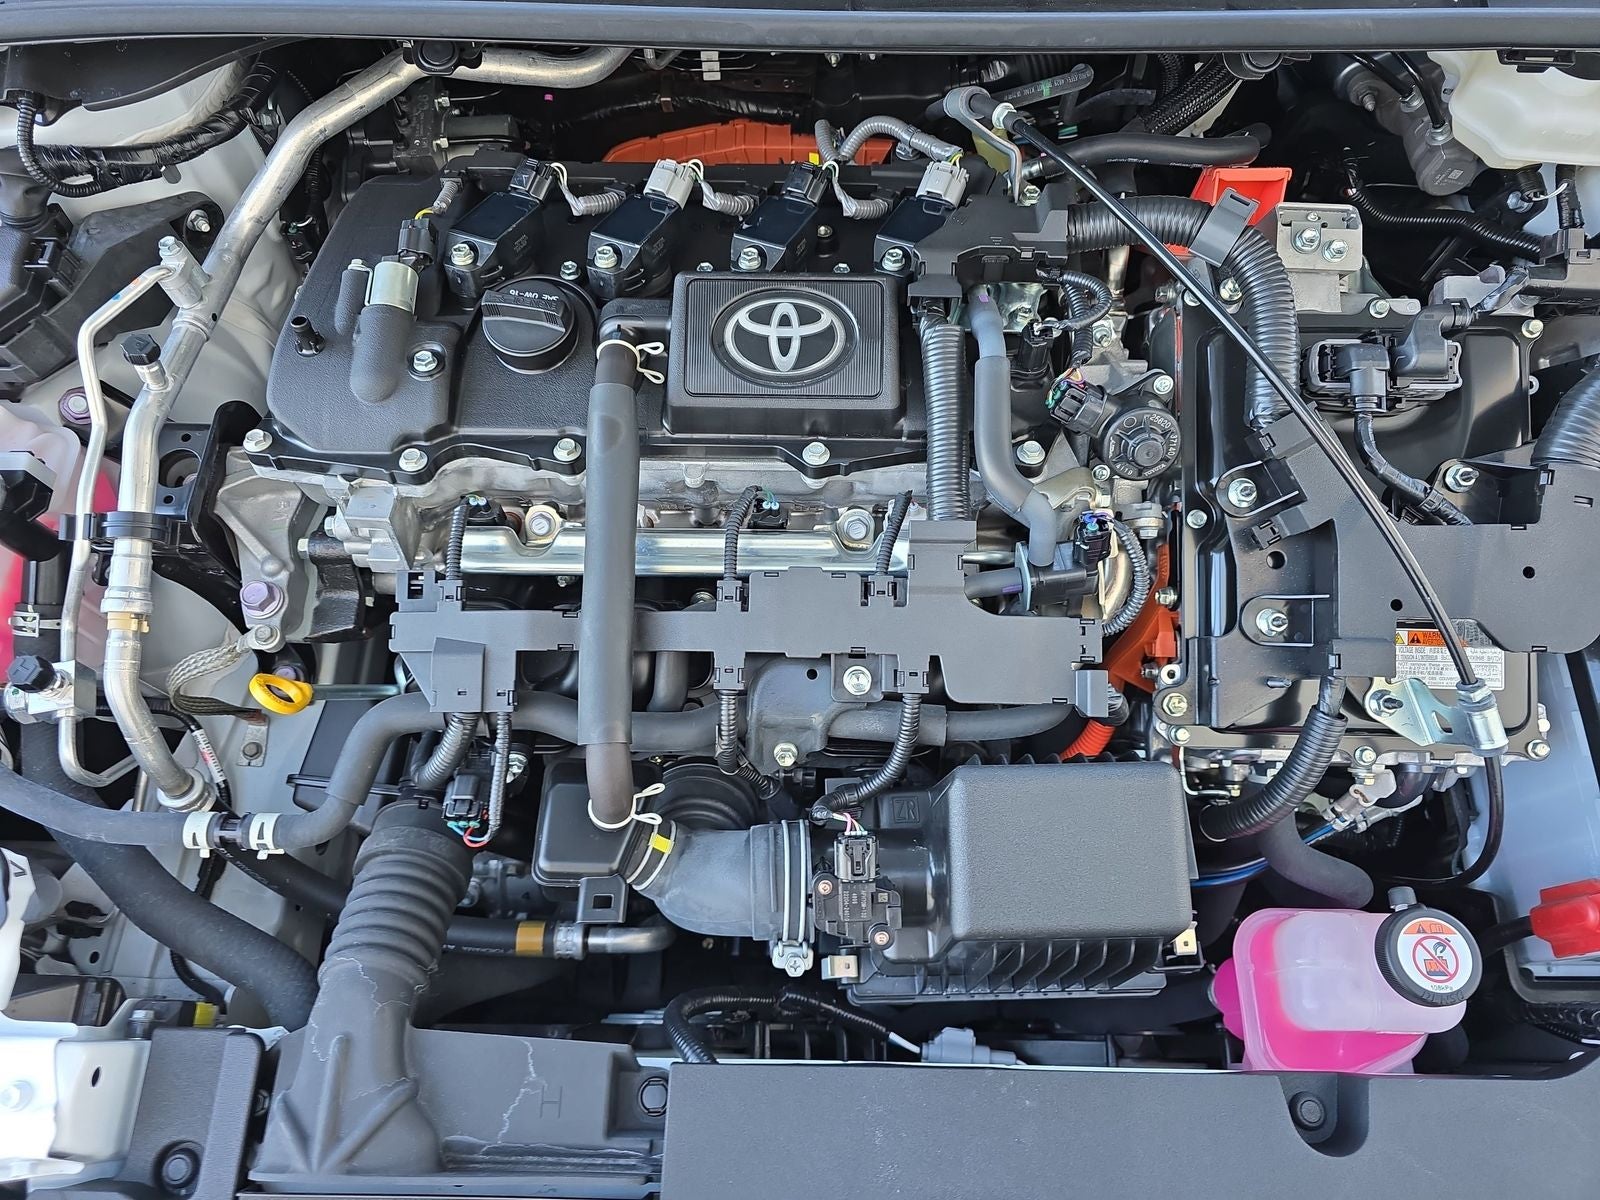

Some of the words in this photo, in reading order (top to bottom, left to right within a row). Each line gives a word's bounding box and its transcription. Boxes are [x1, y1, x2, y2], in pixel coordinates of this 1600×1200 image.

[1167, 434, 1178, 456] 37140
[1143, 463, 1167, 476] TOYOTA
[894, 799, 917, 821] ZR
